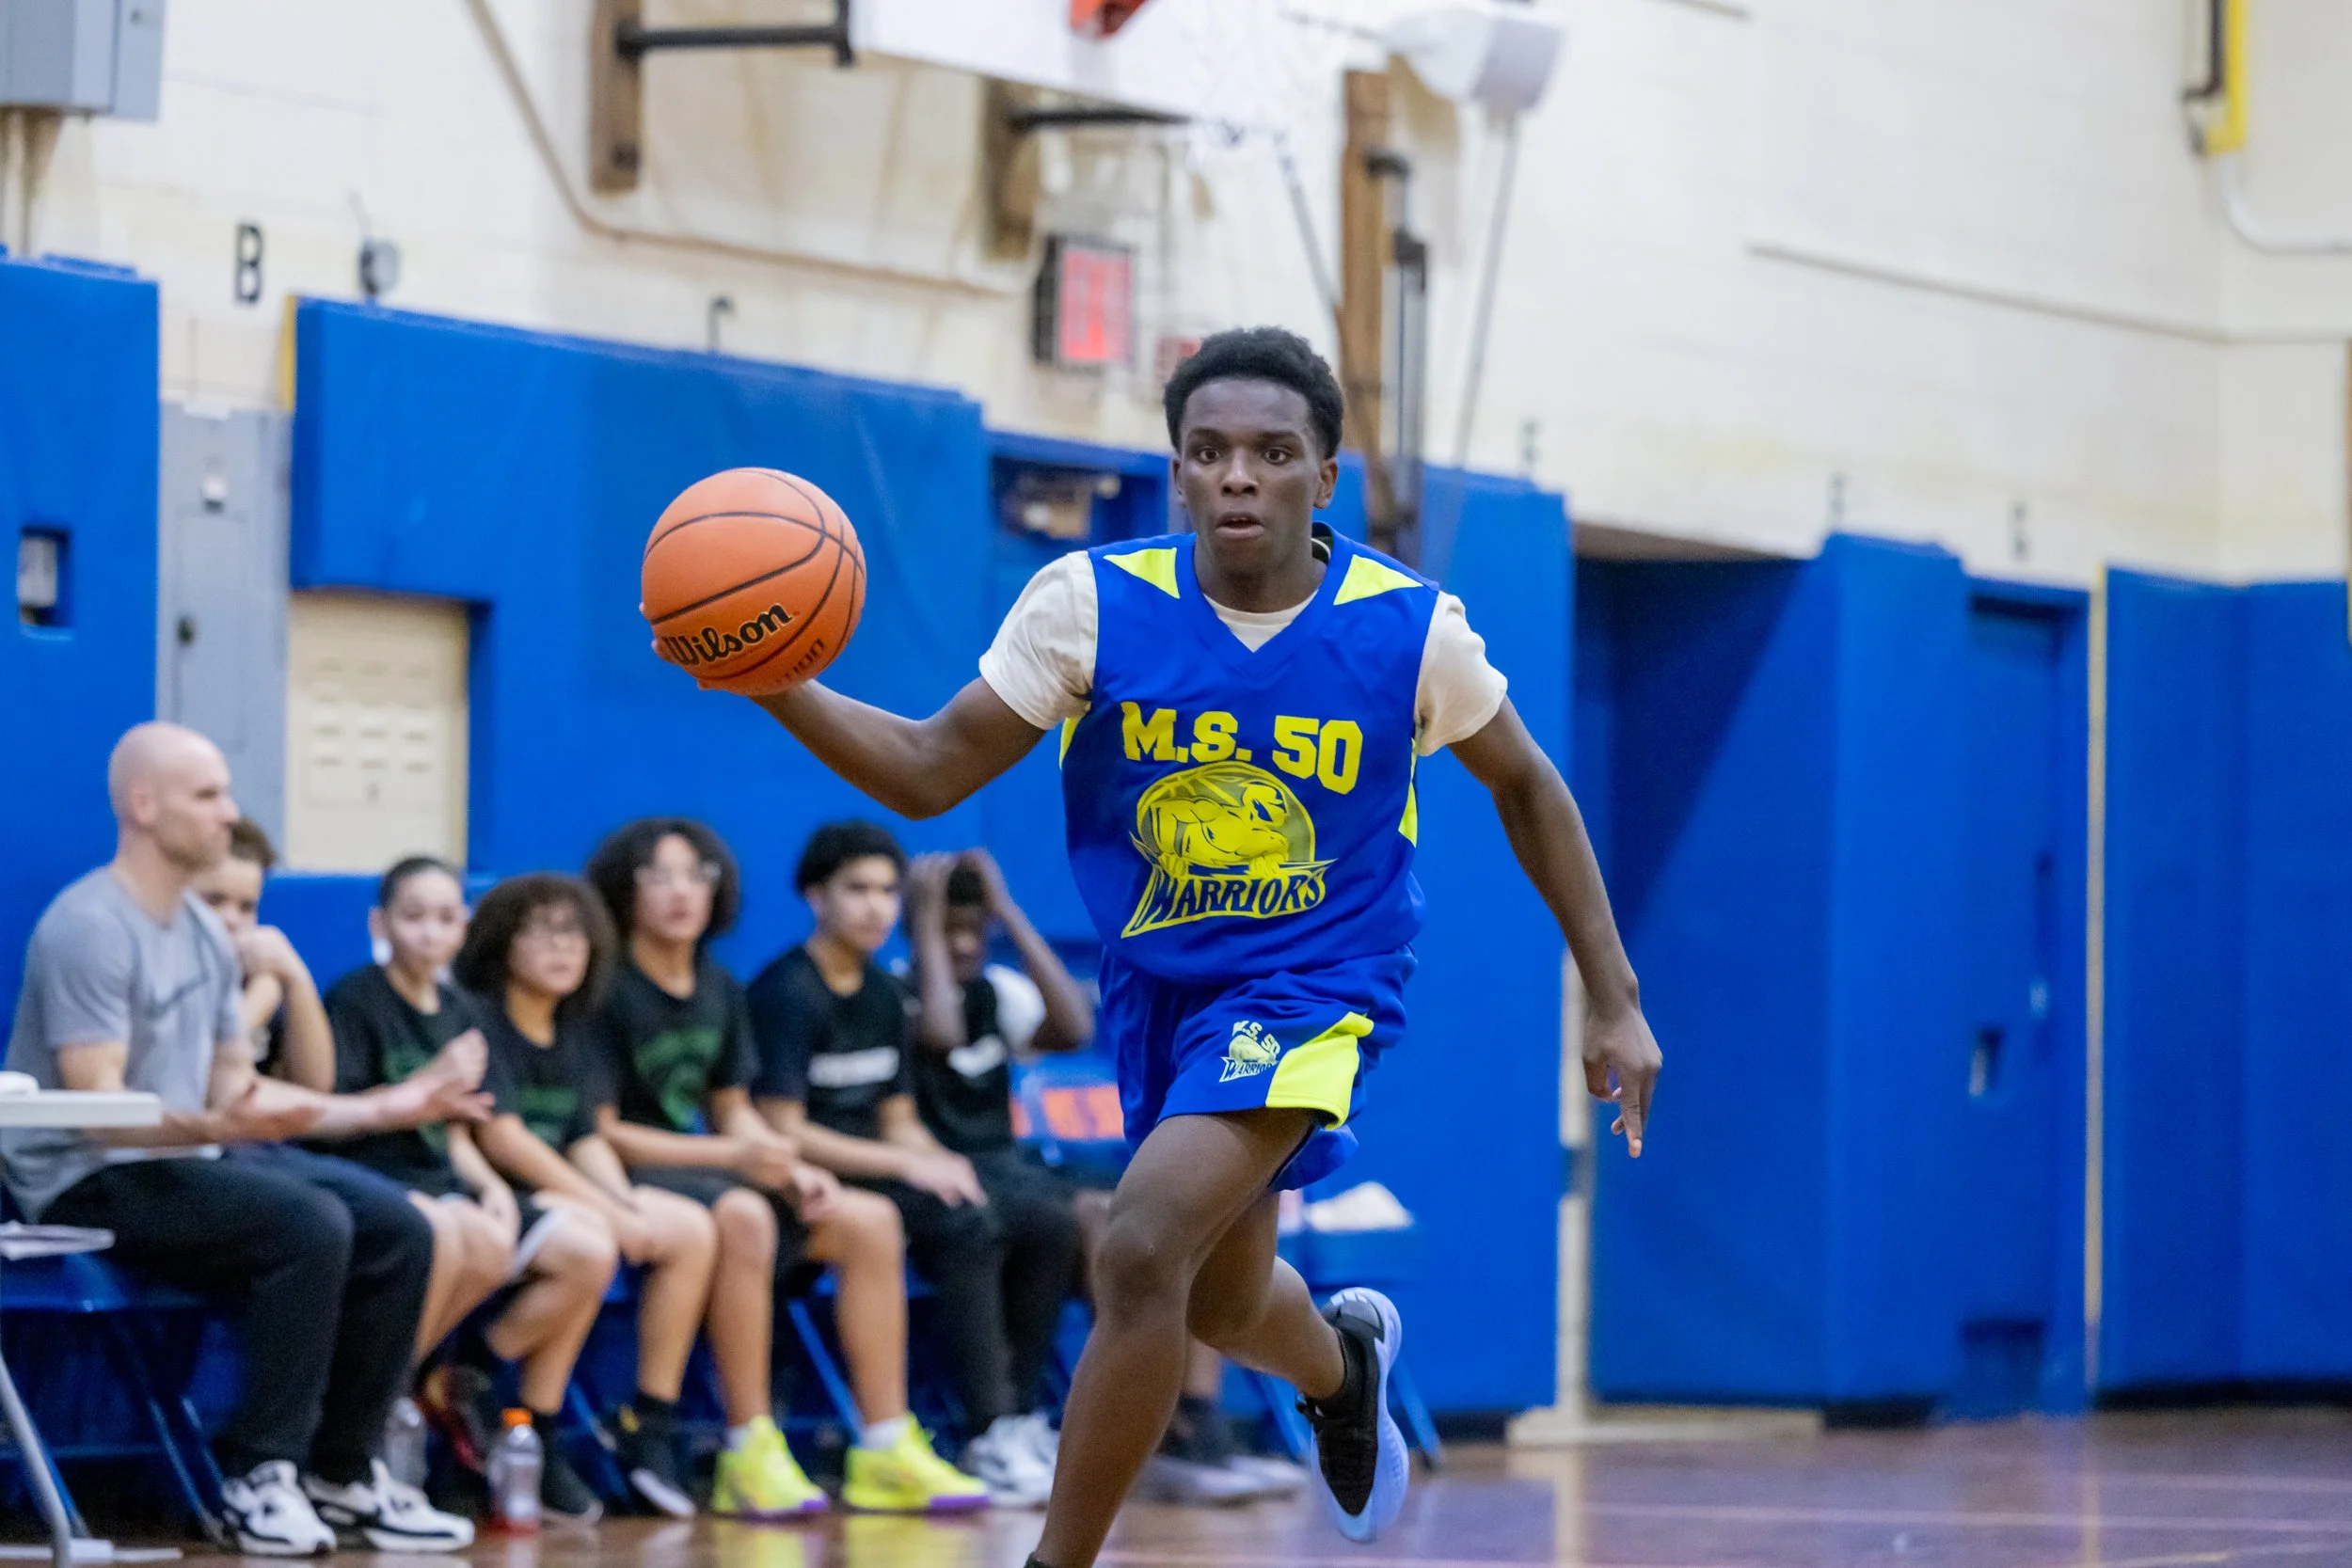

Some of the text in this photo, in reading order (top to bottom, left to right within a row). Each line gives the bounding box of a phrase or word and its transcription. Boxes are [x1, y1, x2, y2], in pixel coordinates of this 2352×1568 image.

[234, 221, 264, 305] B
[662, 603, 792, 666] Wilson
[1120, 702, 1363, 795] M.S. 50
[1129, 864, 1326, 931] WARRIORS
[1220, 1057, 1278, 1082] WARRIO
